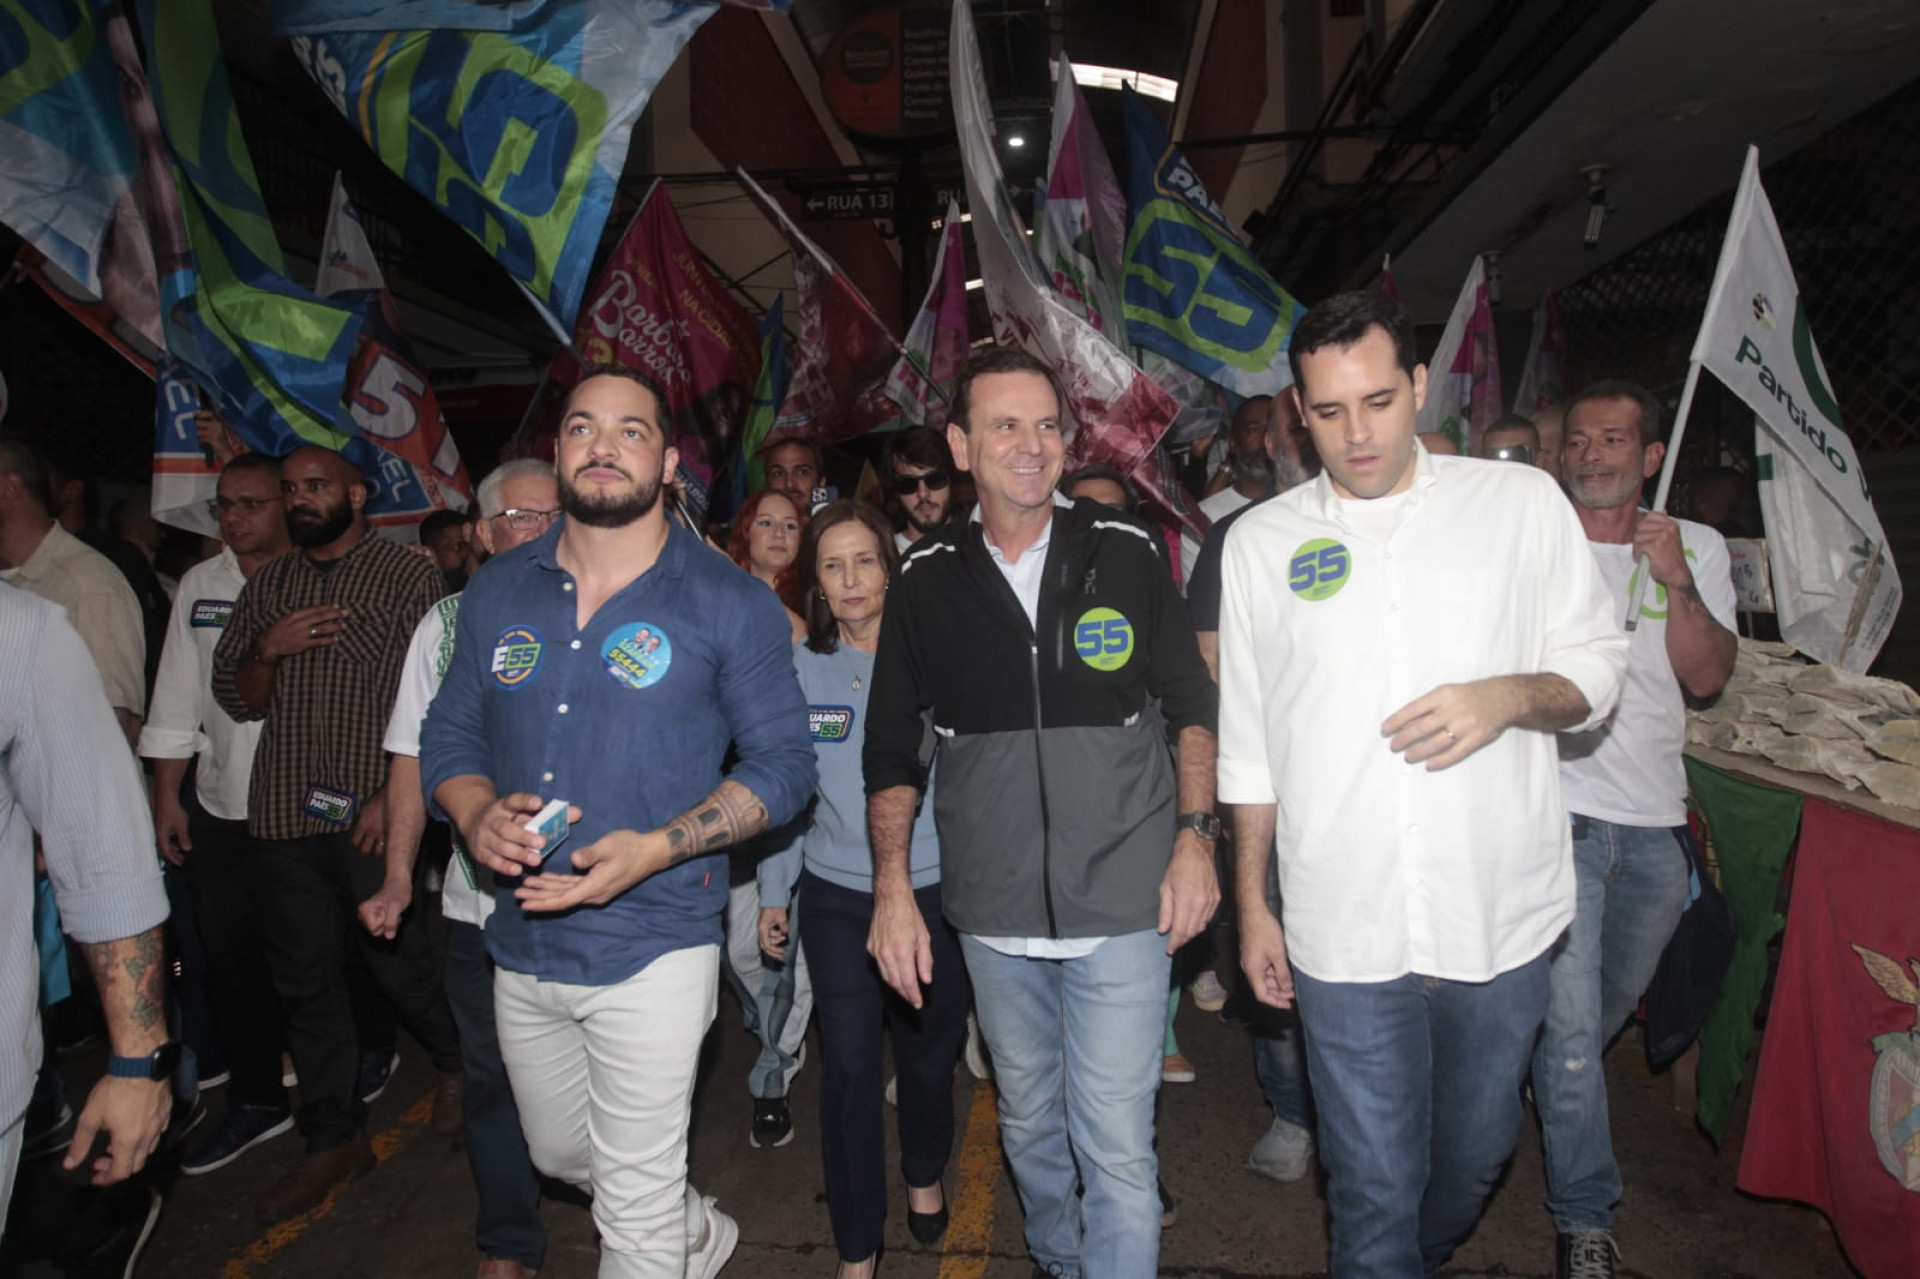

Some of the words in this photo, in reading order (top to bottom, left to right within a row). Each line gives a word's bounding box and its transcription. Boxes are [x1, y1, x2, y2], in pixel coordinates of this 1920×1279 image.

[826, 194, 863, 211] RUA
[869, 193, 889, 210] 13
[936, 188, 967, 206] RU
[1124, 218, 1282, 351] 55
[1734, 335, 1848, 474] Partido
[1290, 544, 1347, 592] 55
[196, 604, 233, 614] EDUARD
[1076, 618, 1131, 657] 55
[608, 648, 647, 678] 55444
[809, 713, 847, 723] UARDO
